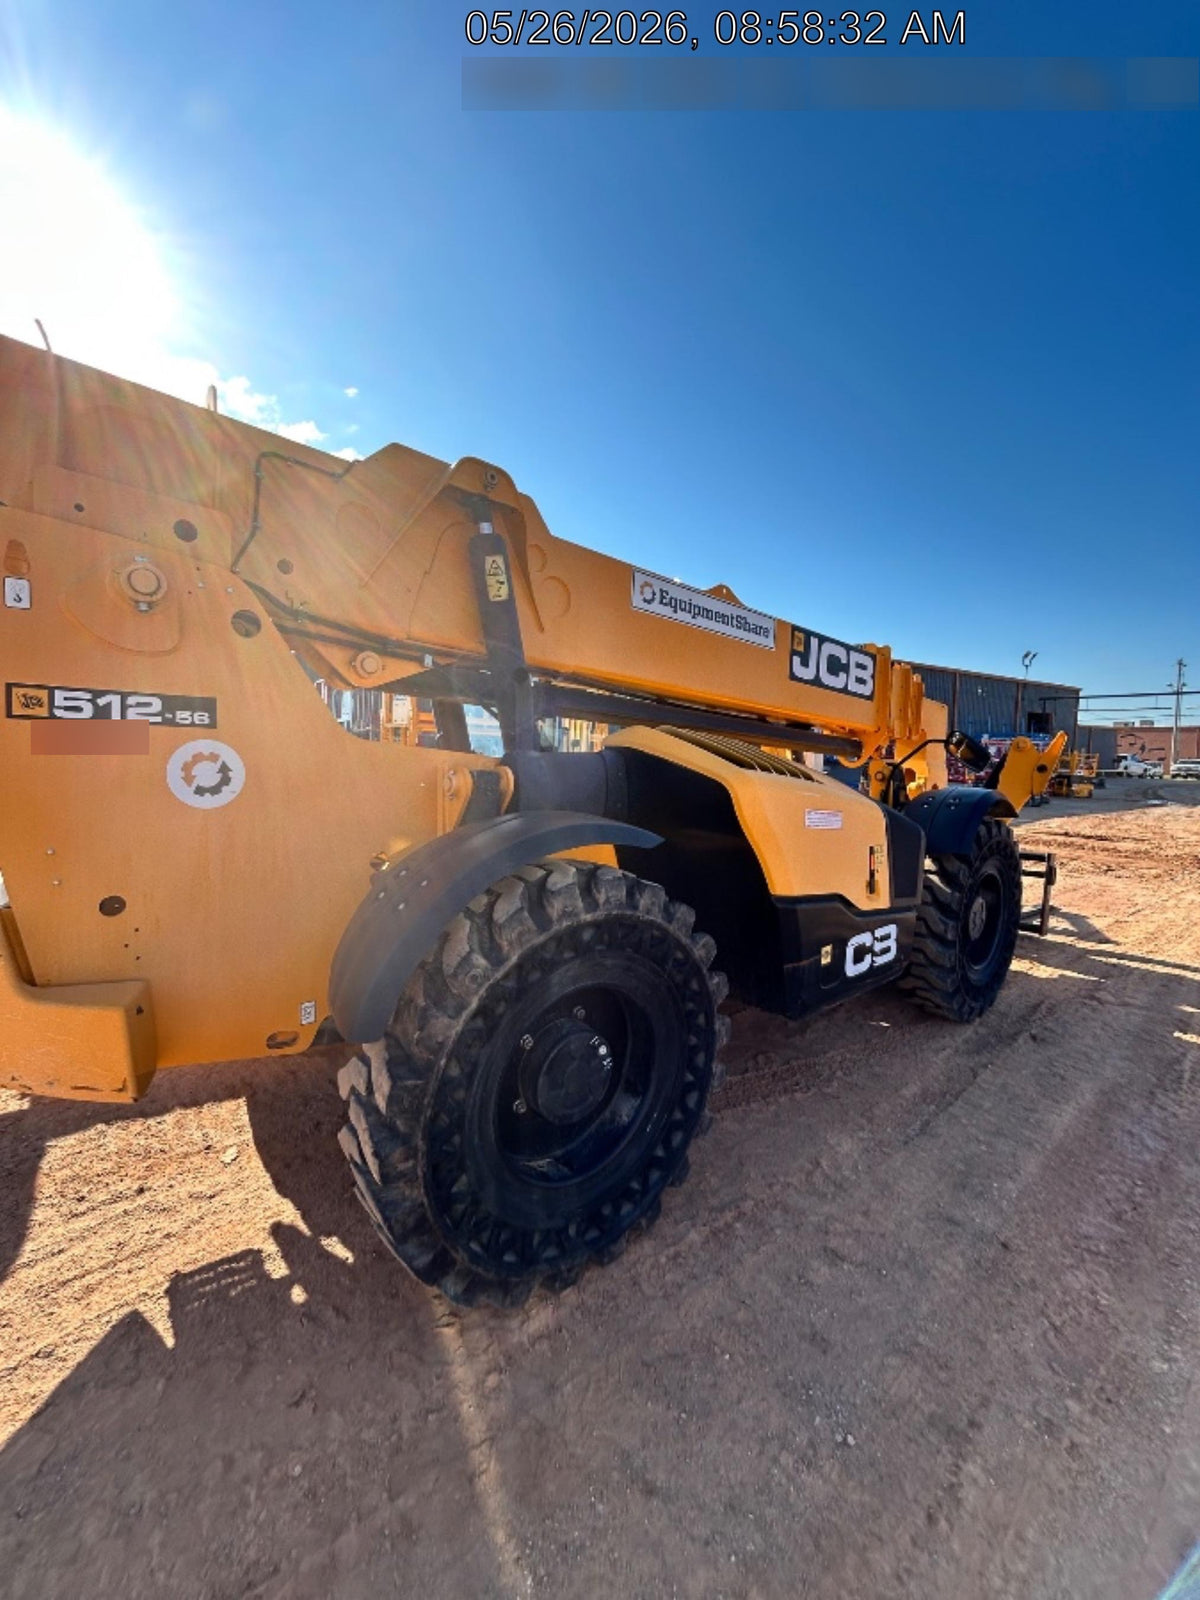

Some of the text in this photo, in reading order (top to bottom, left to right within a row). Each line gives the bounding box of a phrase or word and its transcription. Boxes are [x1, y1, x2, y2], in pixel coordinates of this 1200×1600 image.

[659, 588, 769, 639] EquipmentShare
[792, 635, 874, 696] JCB
[844, 923, 898, 977] C3
